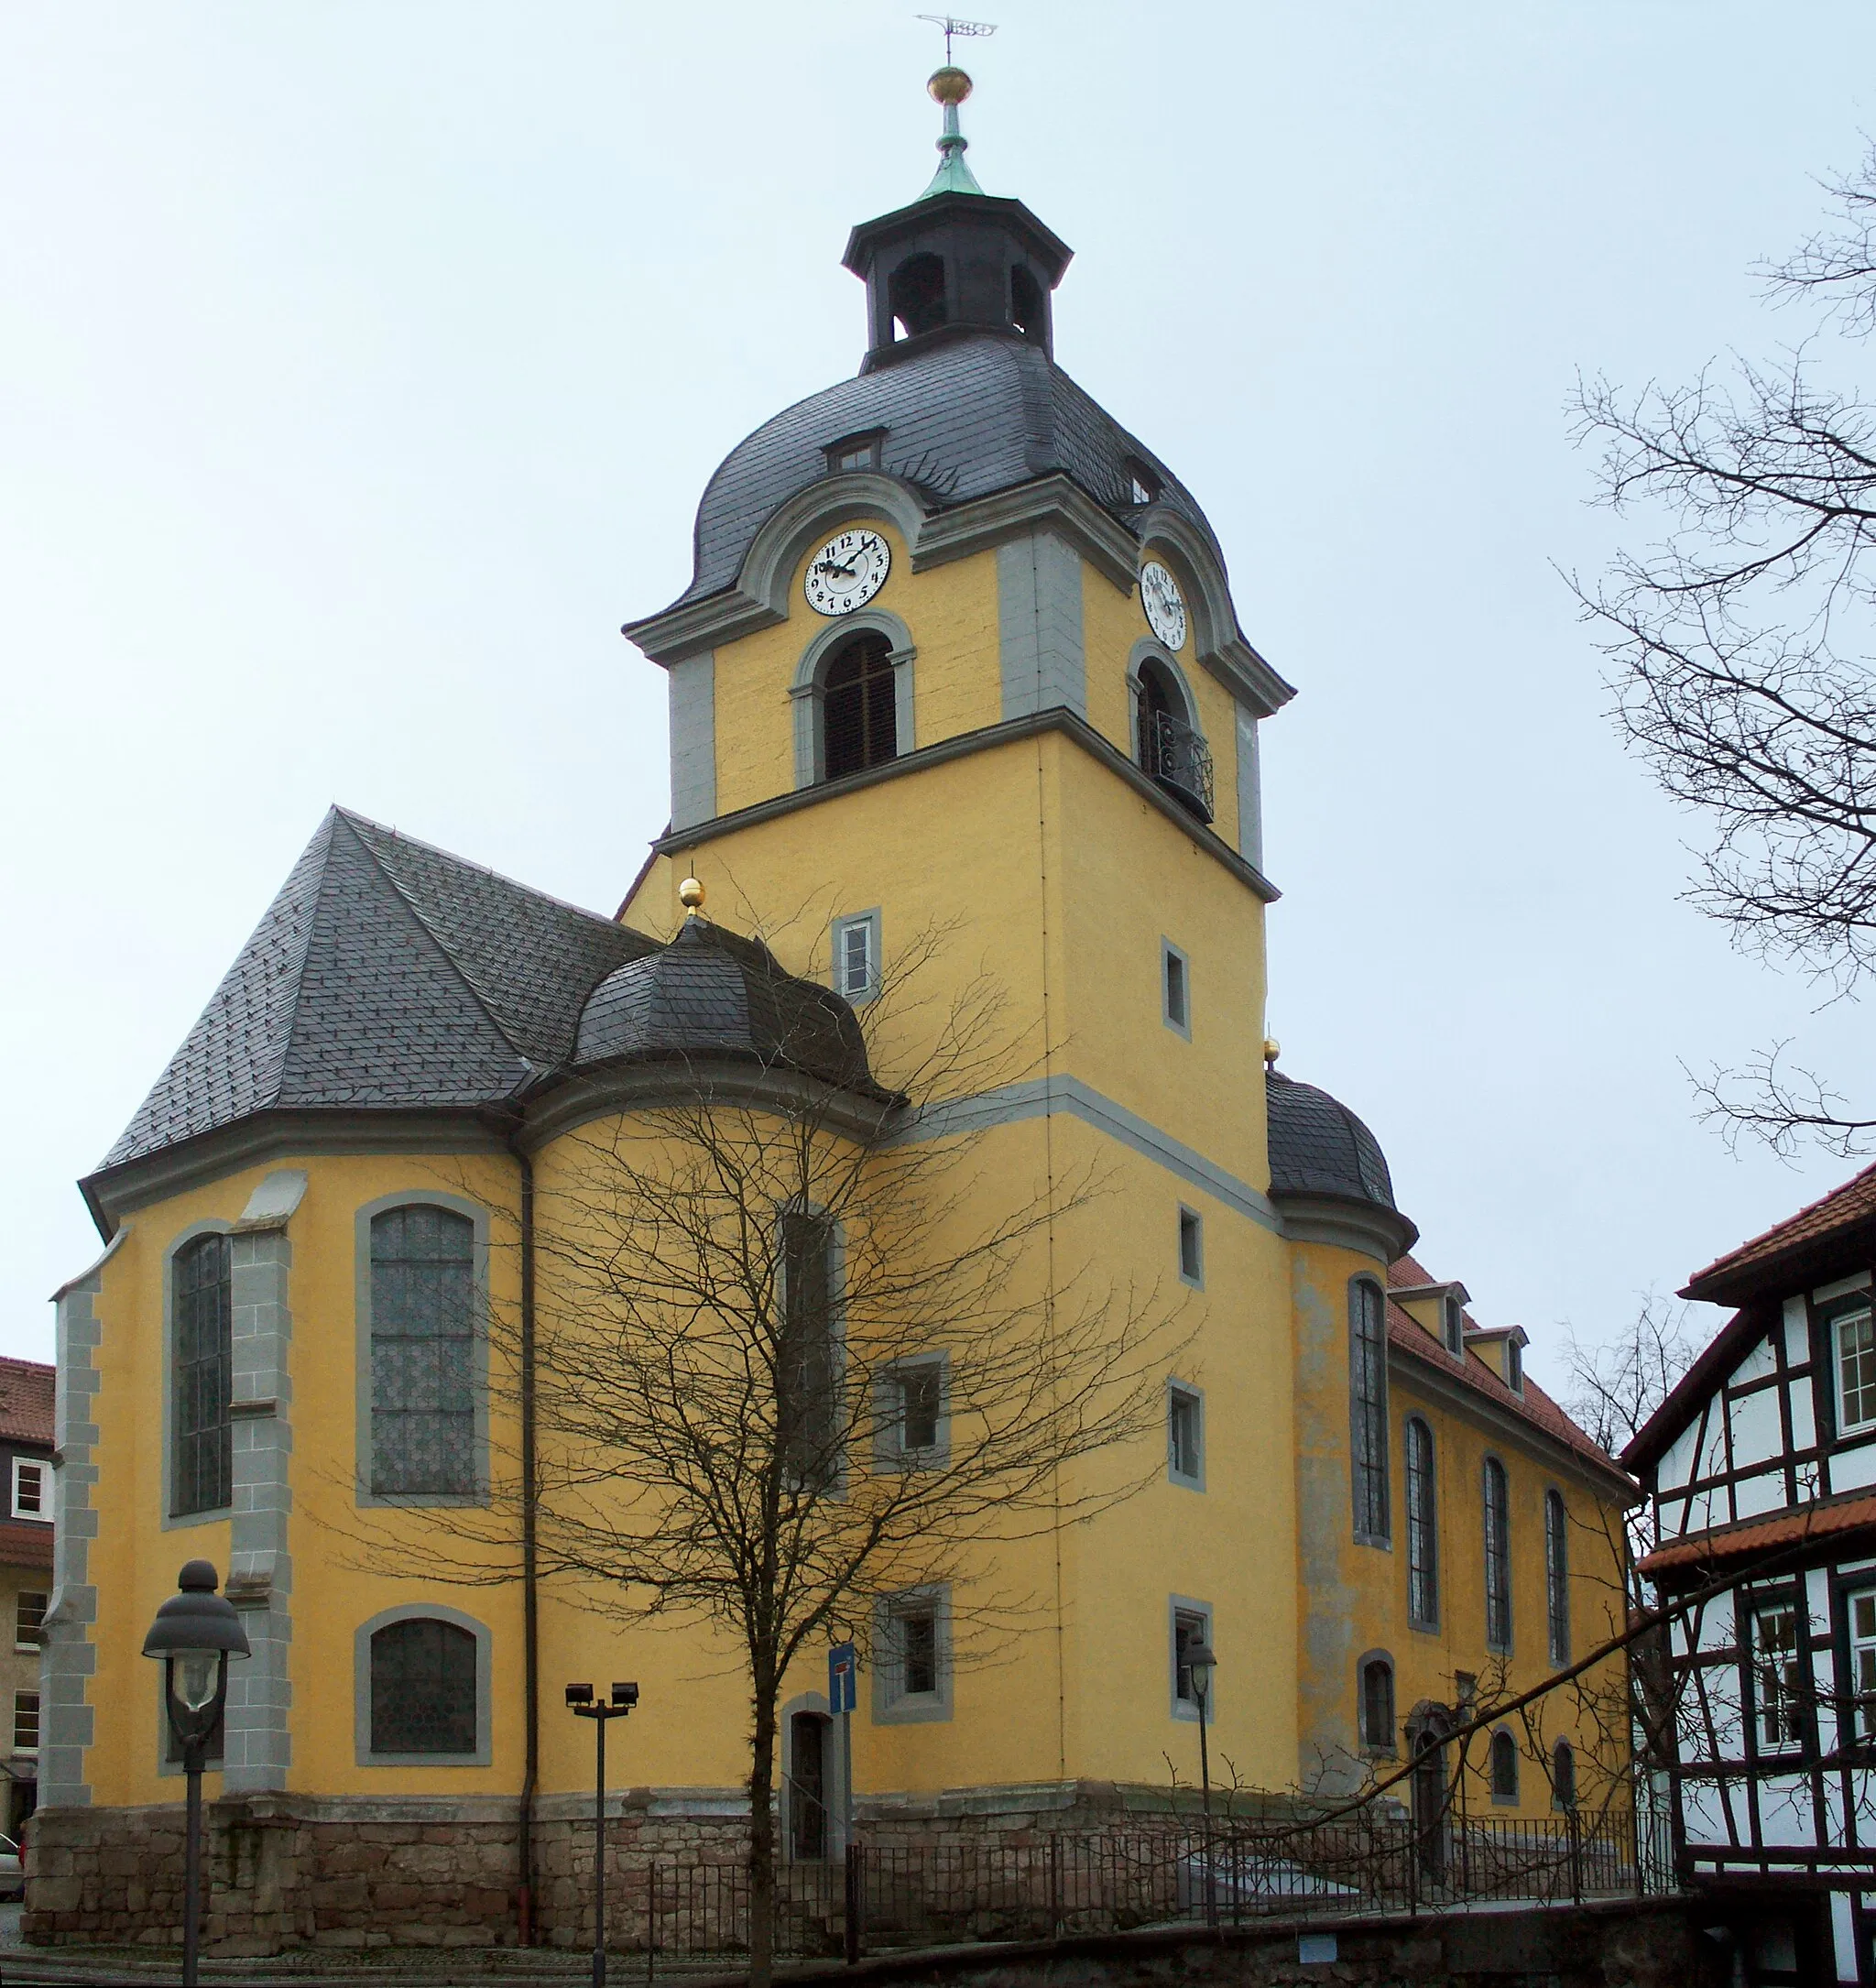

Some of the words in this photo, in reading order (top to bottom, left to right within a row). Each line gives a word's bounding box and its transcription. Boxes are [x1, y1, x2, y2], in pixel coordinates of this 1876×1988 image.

[840, 536, 853, 549] 12
[825, 546, 835, 559] 11
[876, 554, 883, 567] 3
[811, 579, 819, 590] 9
[871, 573, 878, 584] 4
[859, 585, 867, 598] 5
[1171, 584, 1174, 595] 1
[816, 591, 824, 602] 8
[827, 596, 835, 609] 7
[843, 597, 852, 607] 6
[1154, 617, 1159, 629] 7
[1179, 616, 1183, 628] 3
